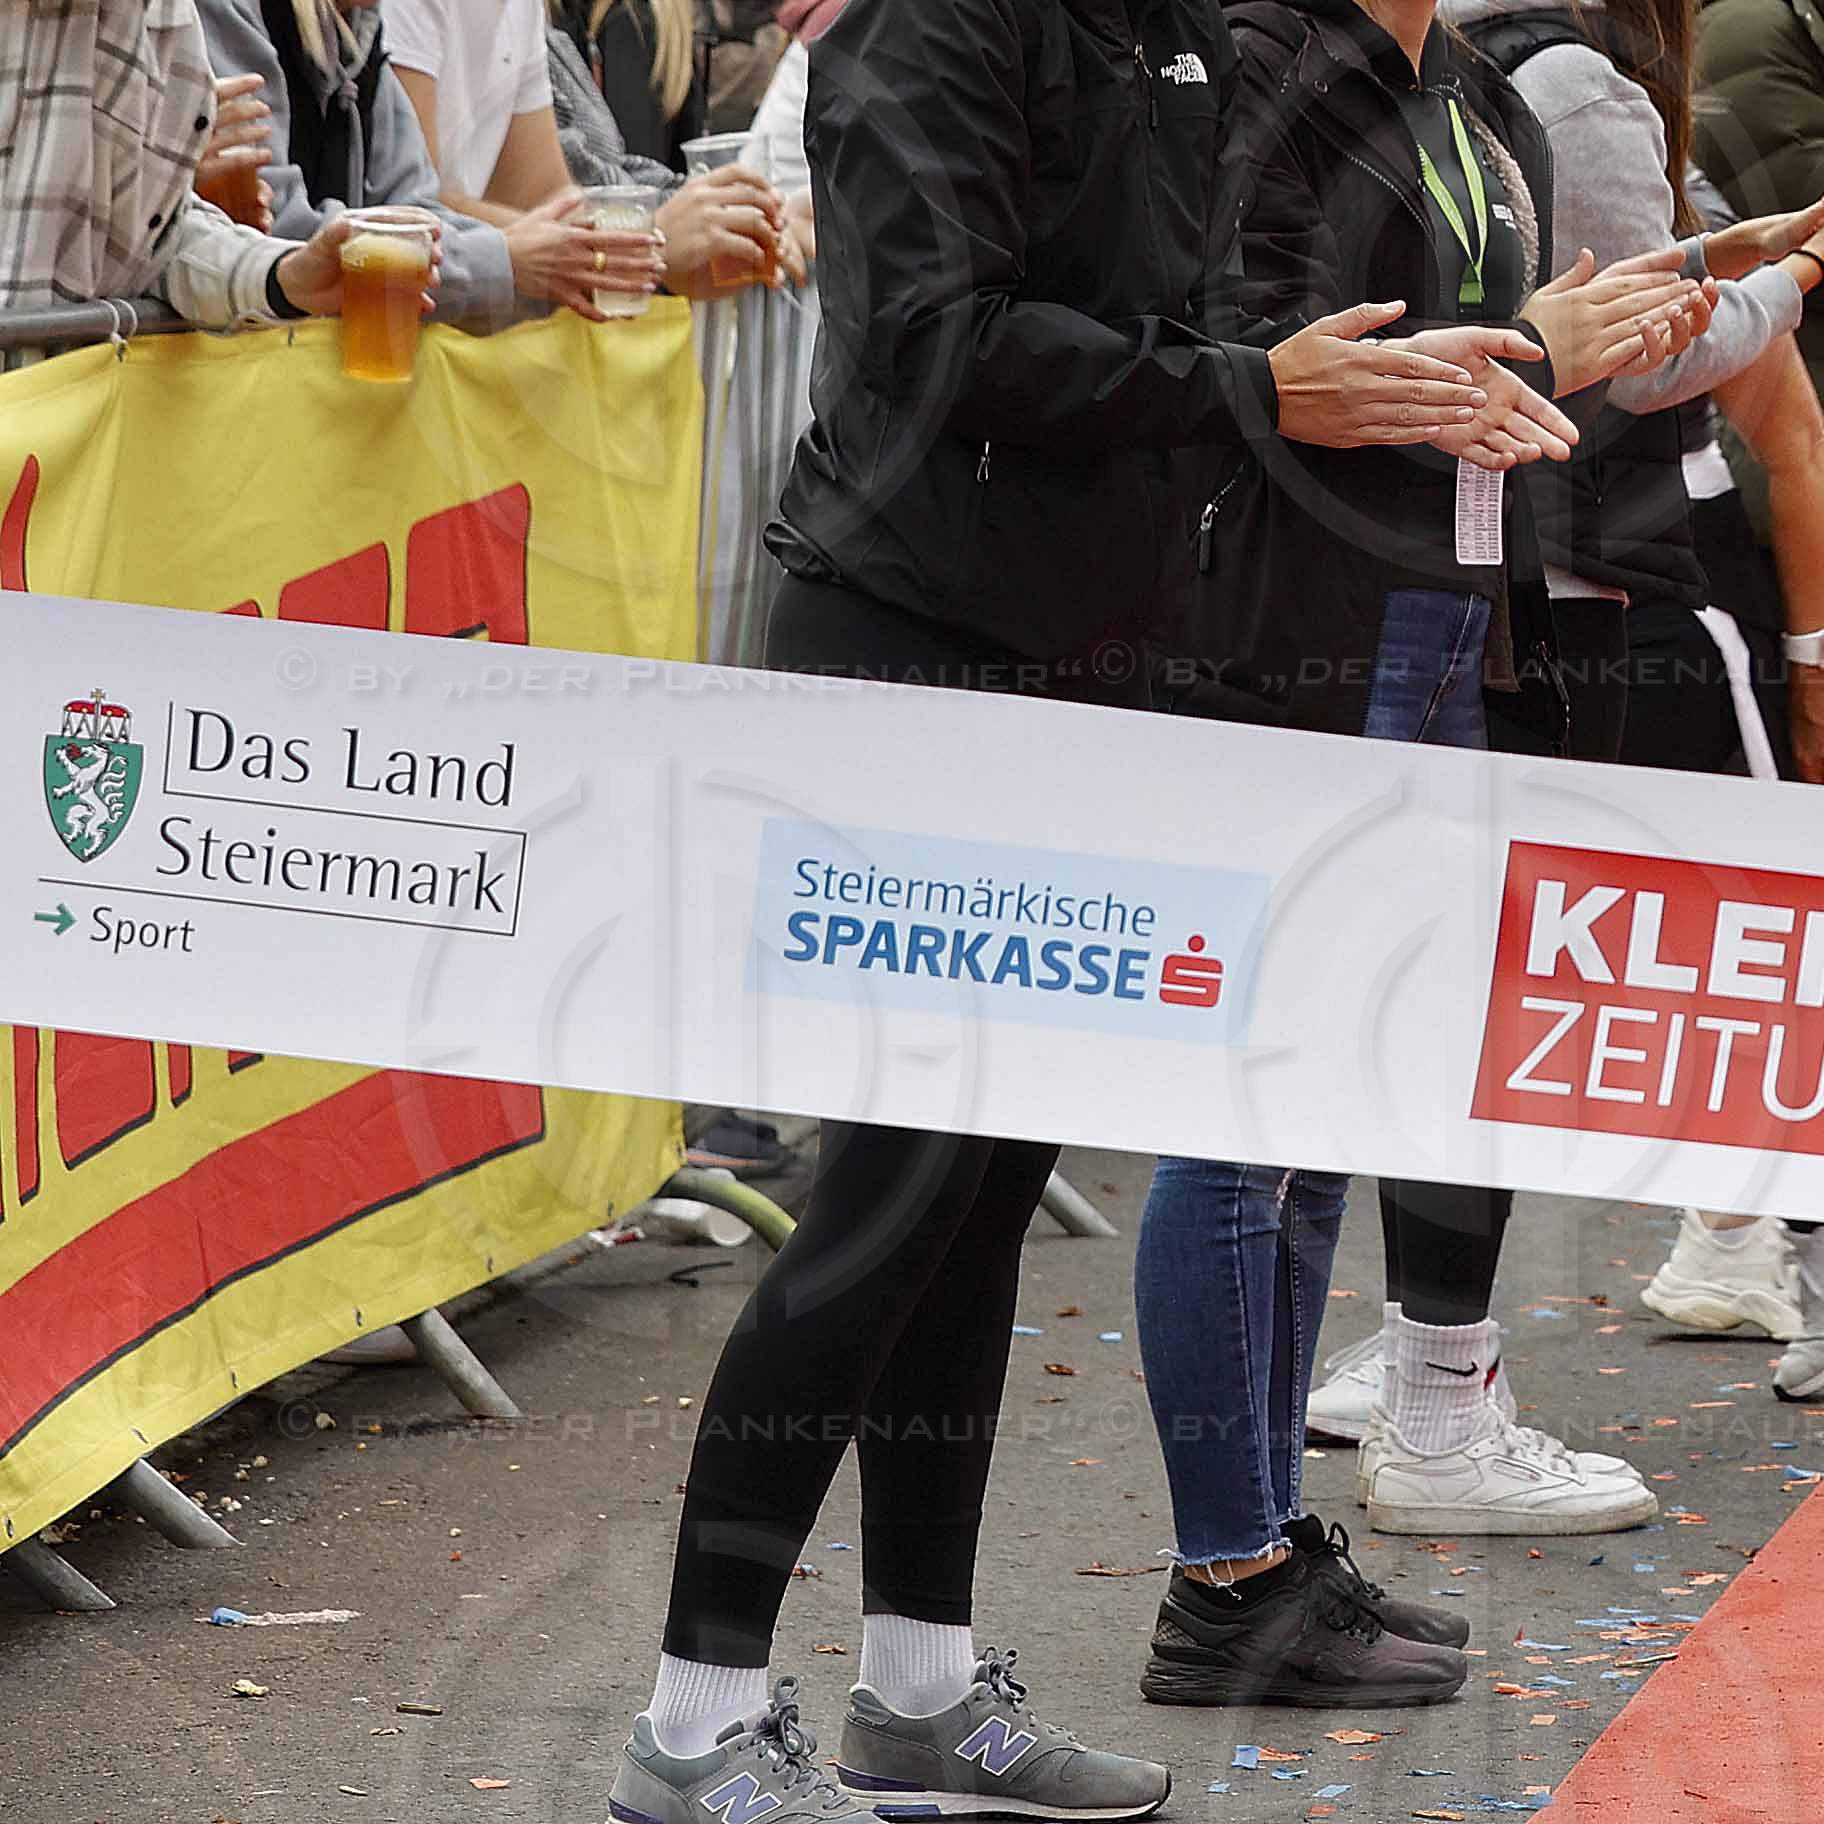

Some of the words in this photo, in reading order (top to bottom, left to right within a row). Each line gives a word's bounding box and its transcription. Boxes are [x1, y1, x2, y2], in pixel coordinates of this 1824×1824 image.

[186, 708, 311, 787] Das
[343, 725, 517, 808] Land
[157, 814, 506, 917] Steiermark
[793, 856, 1158, 939] Steiermärkische
[90, 903, 195, 956] Sport
[782, 909, 1152, 1002] SPARKASSE
